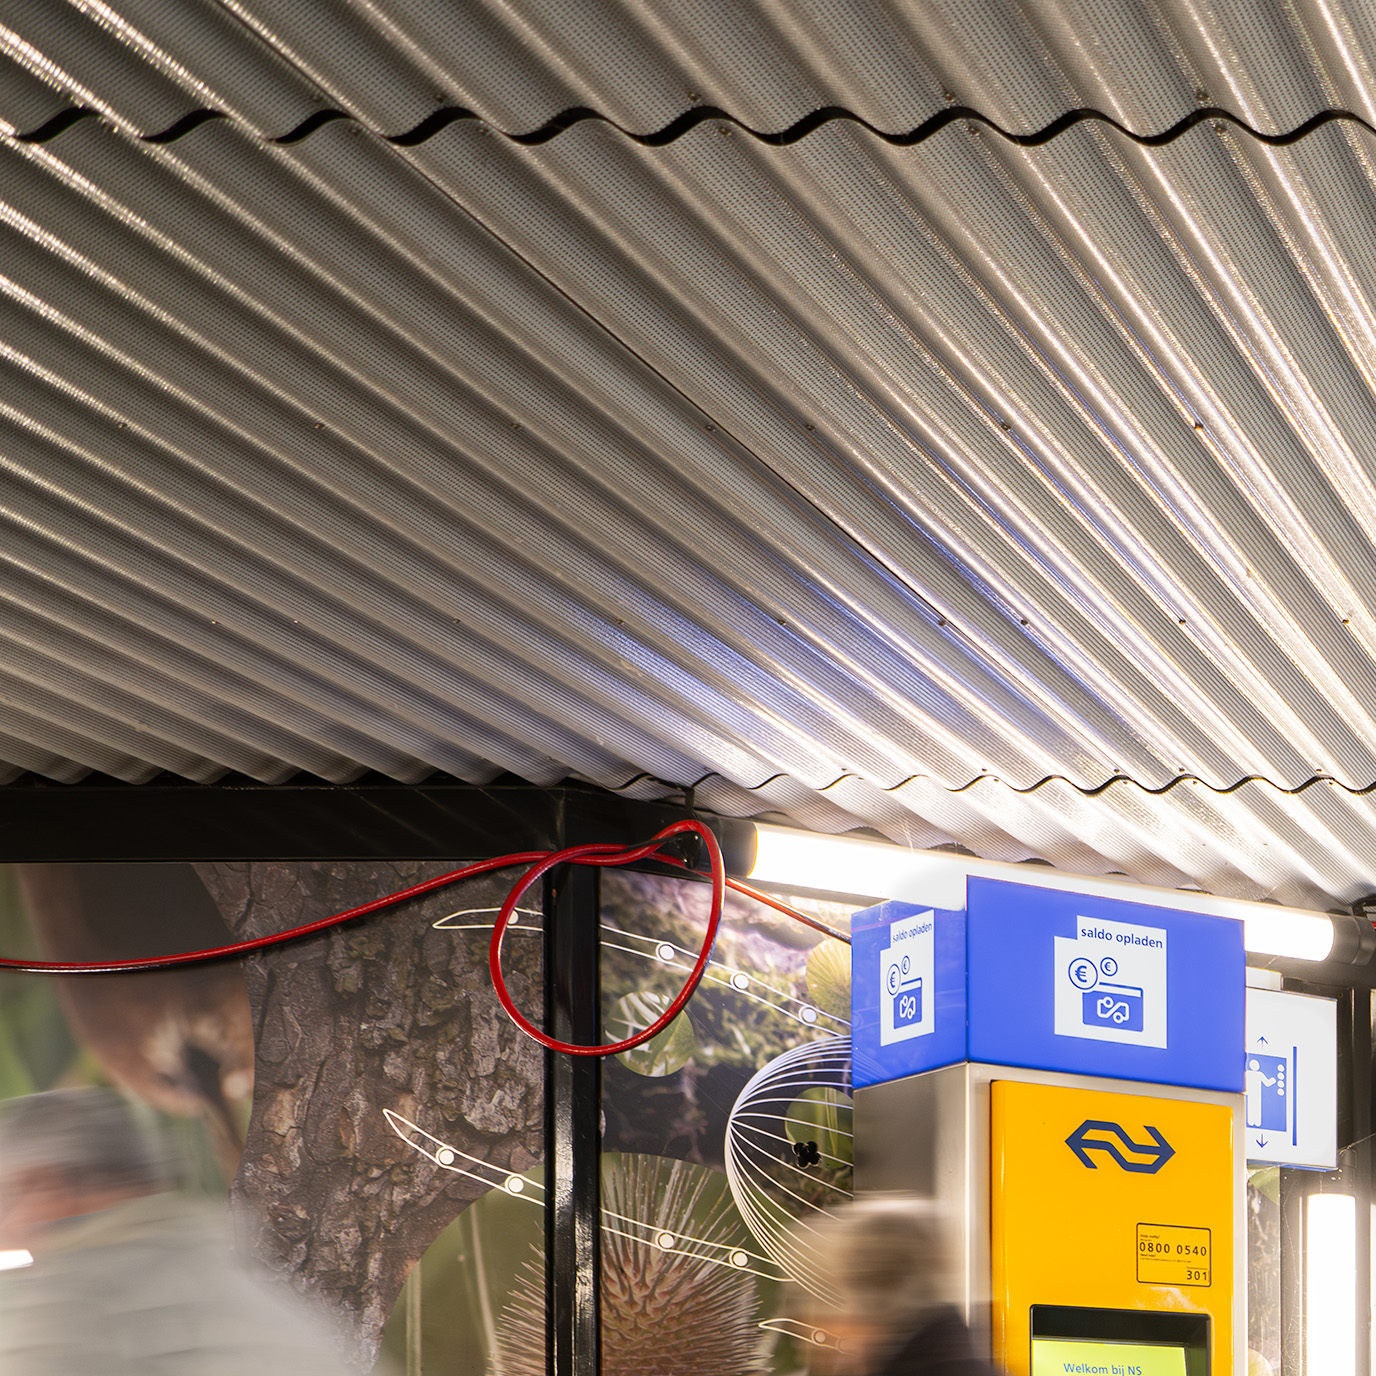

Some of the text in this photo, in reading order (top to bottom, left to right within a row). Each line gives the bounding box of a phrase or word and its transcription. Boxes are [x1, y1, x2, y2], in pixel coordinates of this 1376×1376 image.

[892, 922, 933, 944] saldo opladen
[1081, 926, 1163, 950] saldo opladen
[1140, 1242, 1207, 1256] 0800 0540
[1186, 1270, 1207, 1281] 301
[1063, 1362, 1109, 1375] Welkom
[1128, 1365, 1142, 1376] NS
